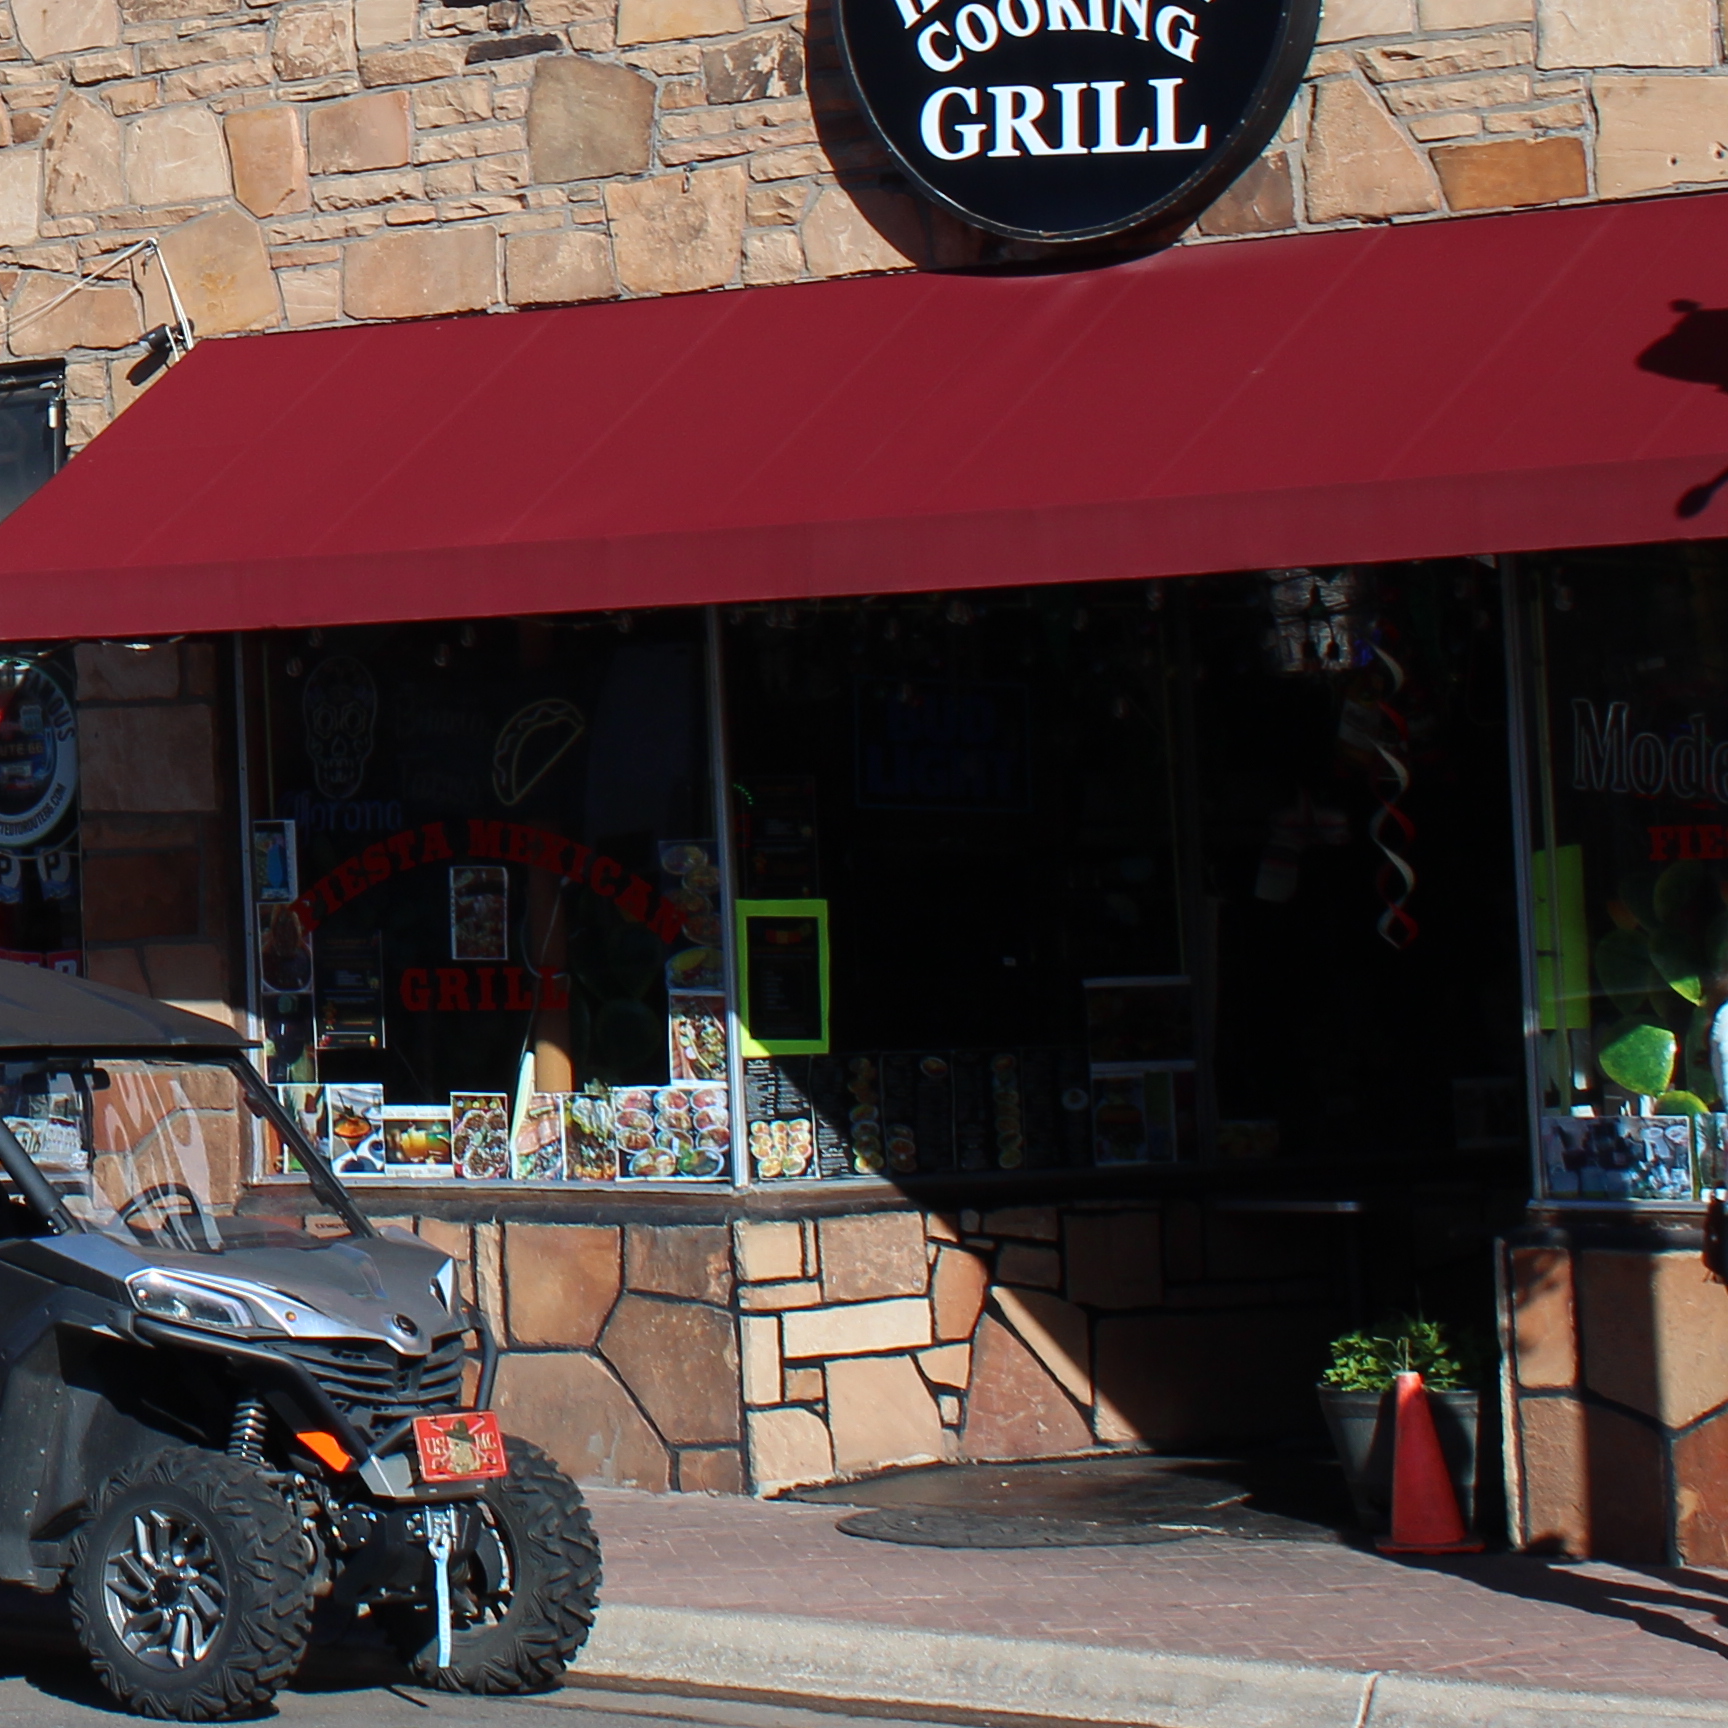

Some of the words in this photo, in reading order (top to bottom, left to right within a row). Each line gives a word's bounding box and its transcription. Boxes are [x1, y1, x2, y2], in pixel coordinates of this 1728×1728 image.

[920, 77, 1208, 162] GRILL
[288, 821, 453, 933] FIESTA
[466, 819, 689, 945] MEXICAN
[399, 966, 571, 1012] GRILL
